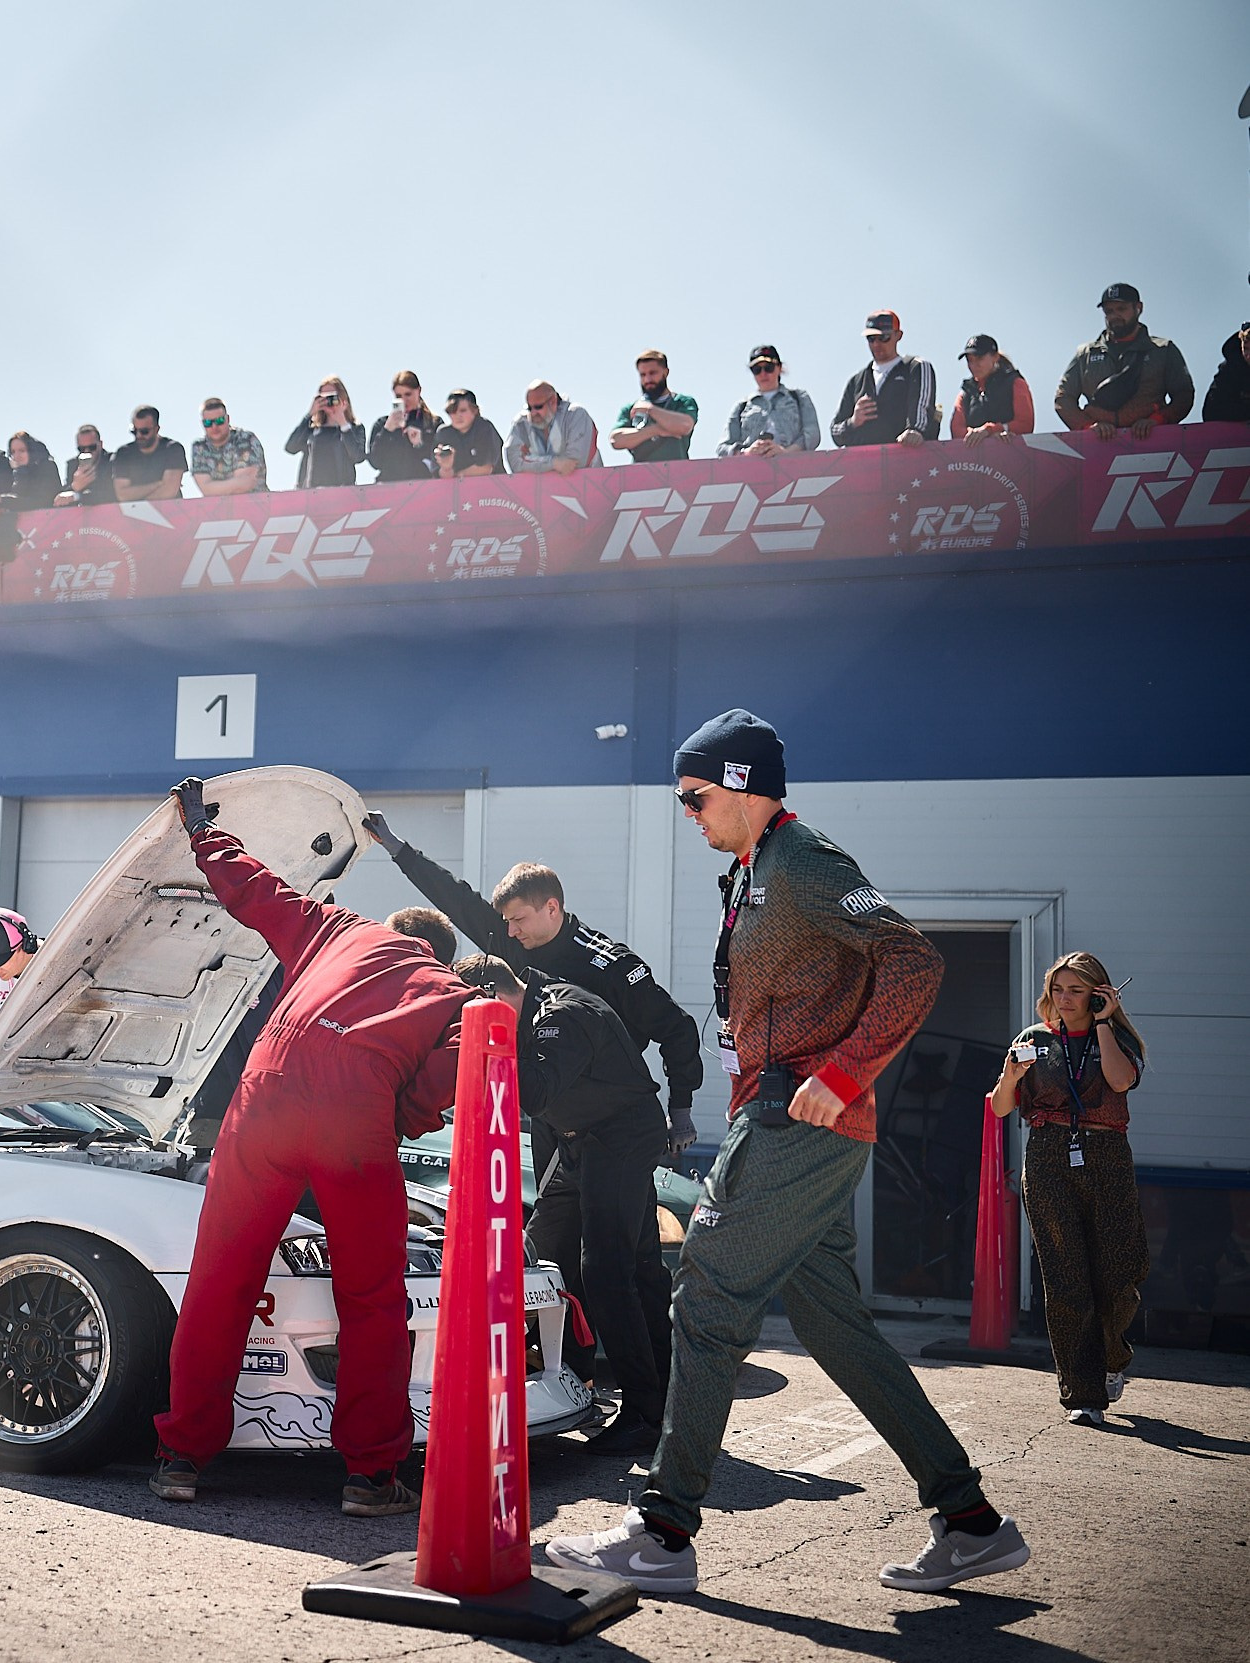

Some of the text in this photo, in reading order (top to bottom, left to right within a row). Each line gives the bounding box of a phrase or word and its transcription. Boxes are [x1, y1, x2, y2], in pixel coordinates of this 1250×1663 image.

[948, 462, 1029, 528] RUSSIAN DRIFT SERIES
[1091, 447, 1250, 532] RD
[478, 498, 546, 557] RUSSIAN DRIFT SERIES
[599, 475, 845, 563] RDS
[910, 502, 1007, 536] RDS
[79, 528, 112, 538] RUSSIAN
[940, 536, 993, 548] EUROPE
[446, 535, 529, 566] RDS
[50, 561, 122, 591] RDS
[471, 565, 517, 578] EUROPE
[205, 694, 228, 737] 1
[628, 966, 647, 983] OMP
[538, 1029, 560, 1037] OMP
[1037, 1046, 1049, 1056] R
[247, 1337, 275, 1345] ACING
[242, 1355, 284, 1371] MOL
